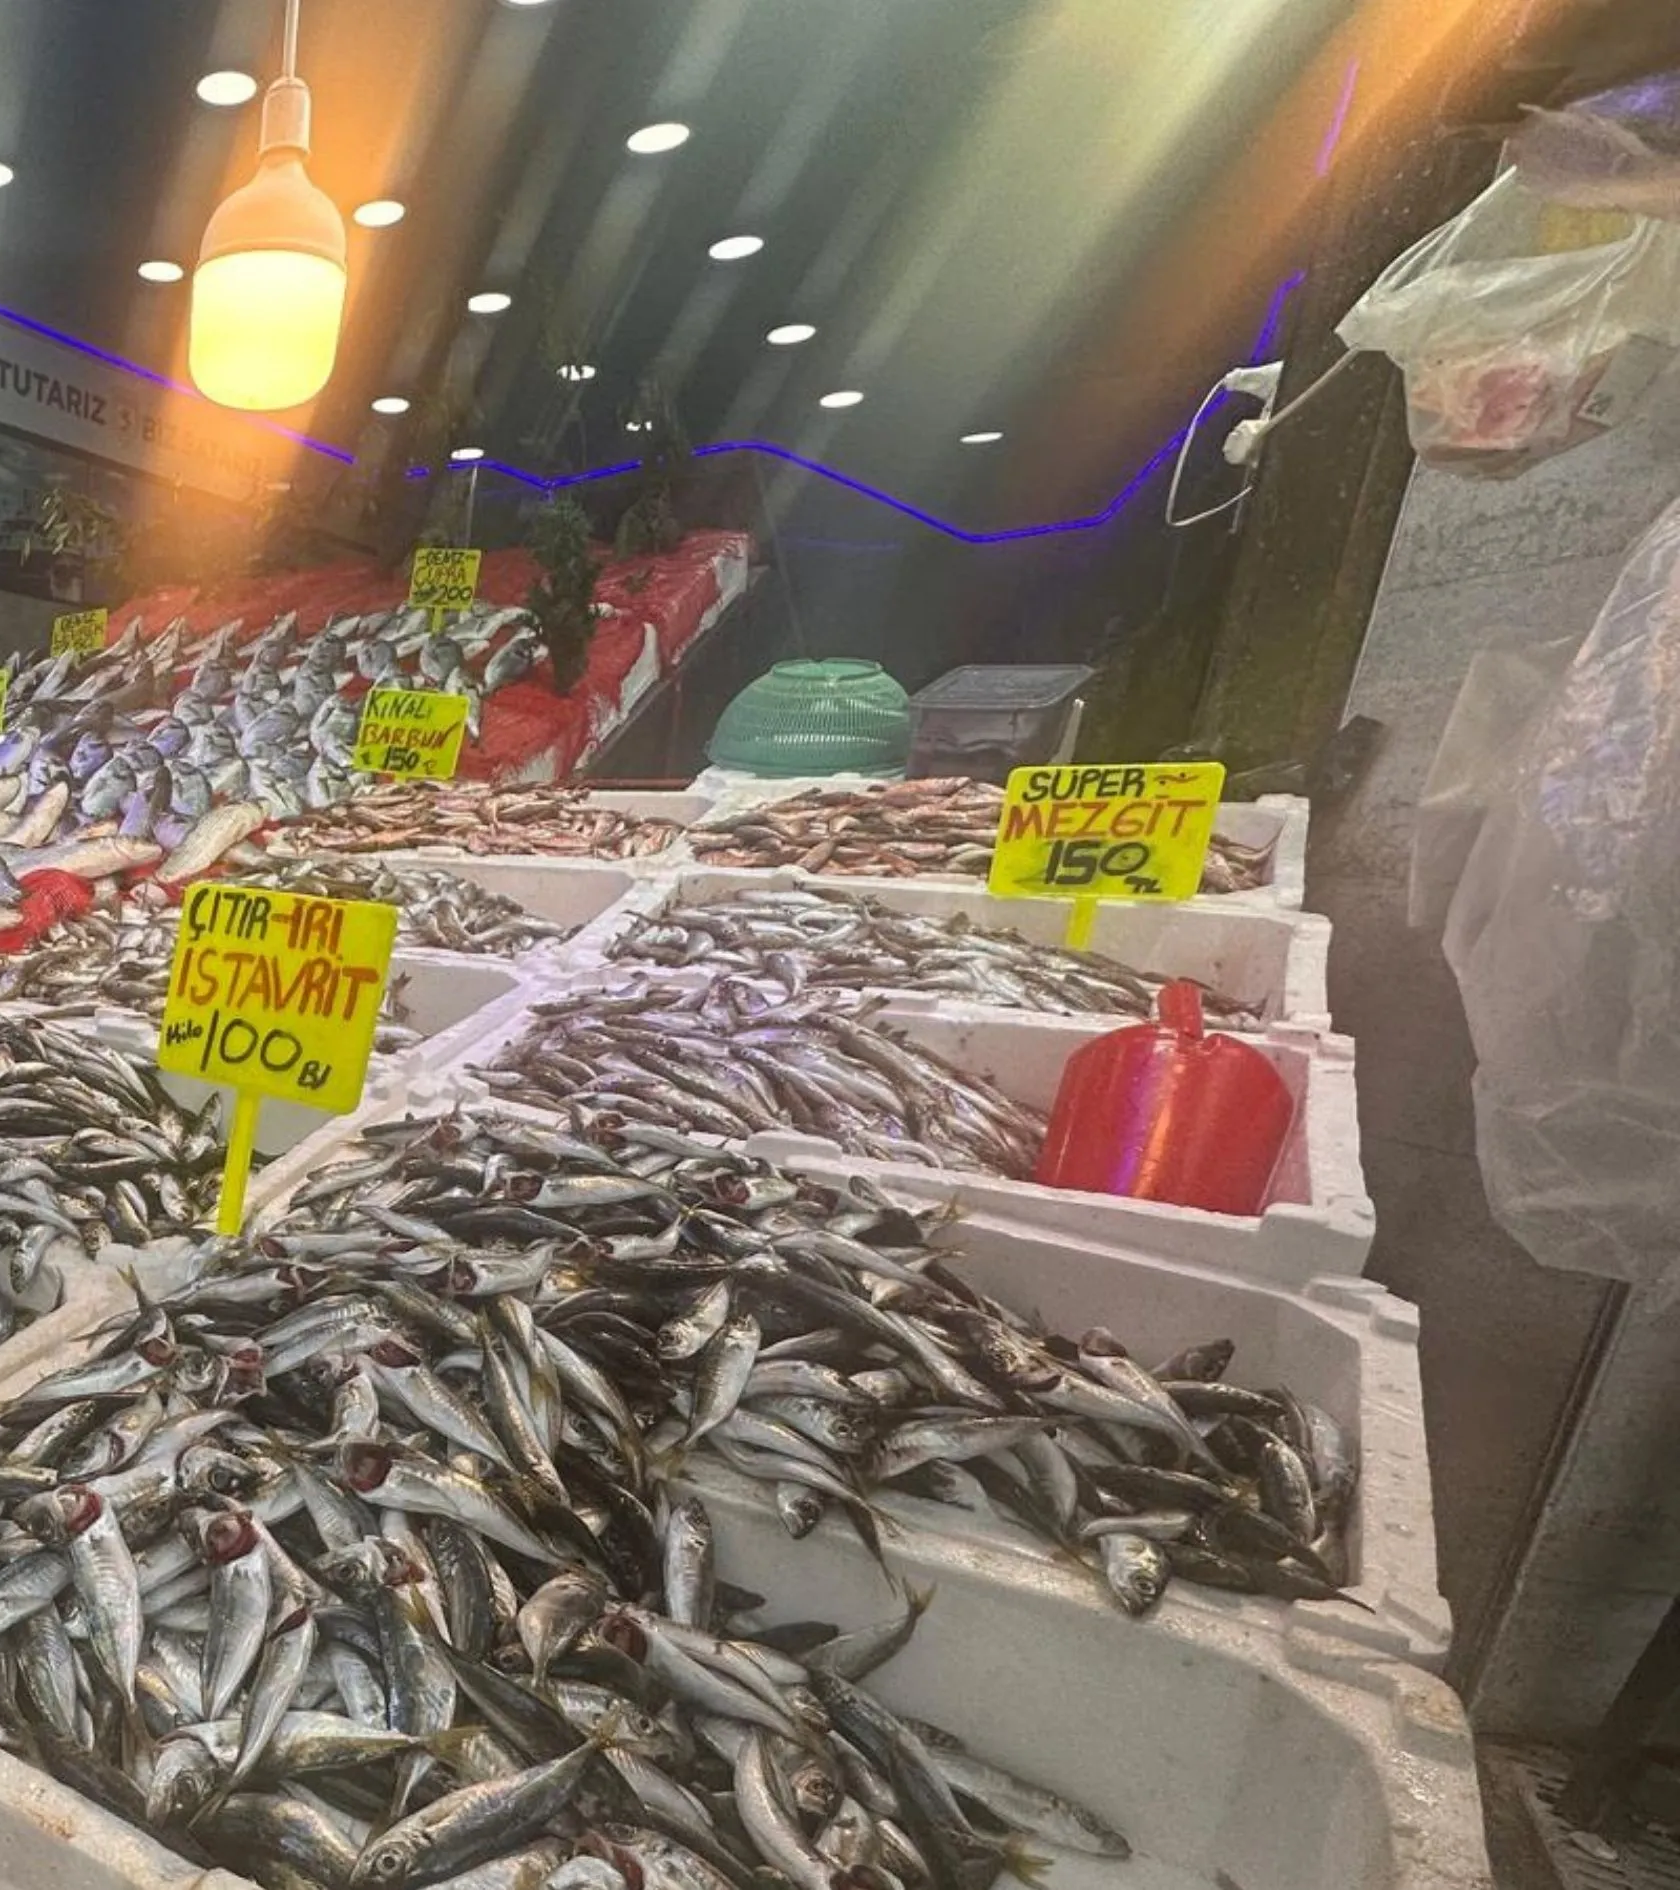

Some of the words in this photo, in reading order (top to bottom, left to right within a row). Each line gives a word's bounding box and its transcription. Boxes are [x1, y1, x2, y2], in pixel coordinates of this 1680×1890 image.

[360, 722, 461, 750] BARBUN
[381, 746, 420, 771] 150
[1042, 839, 1150, 885] 150
[199, 1009, 304, 1073] 100
